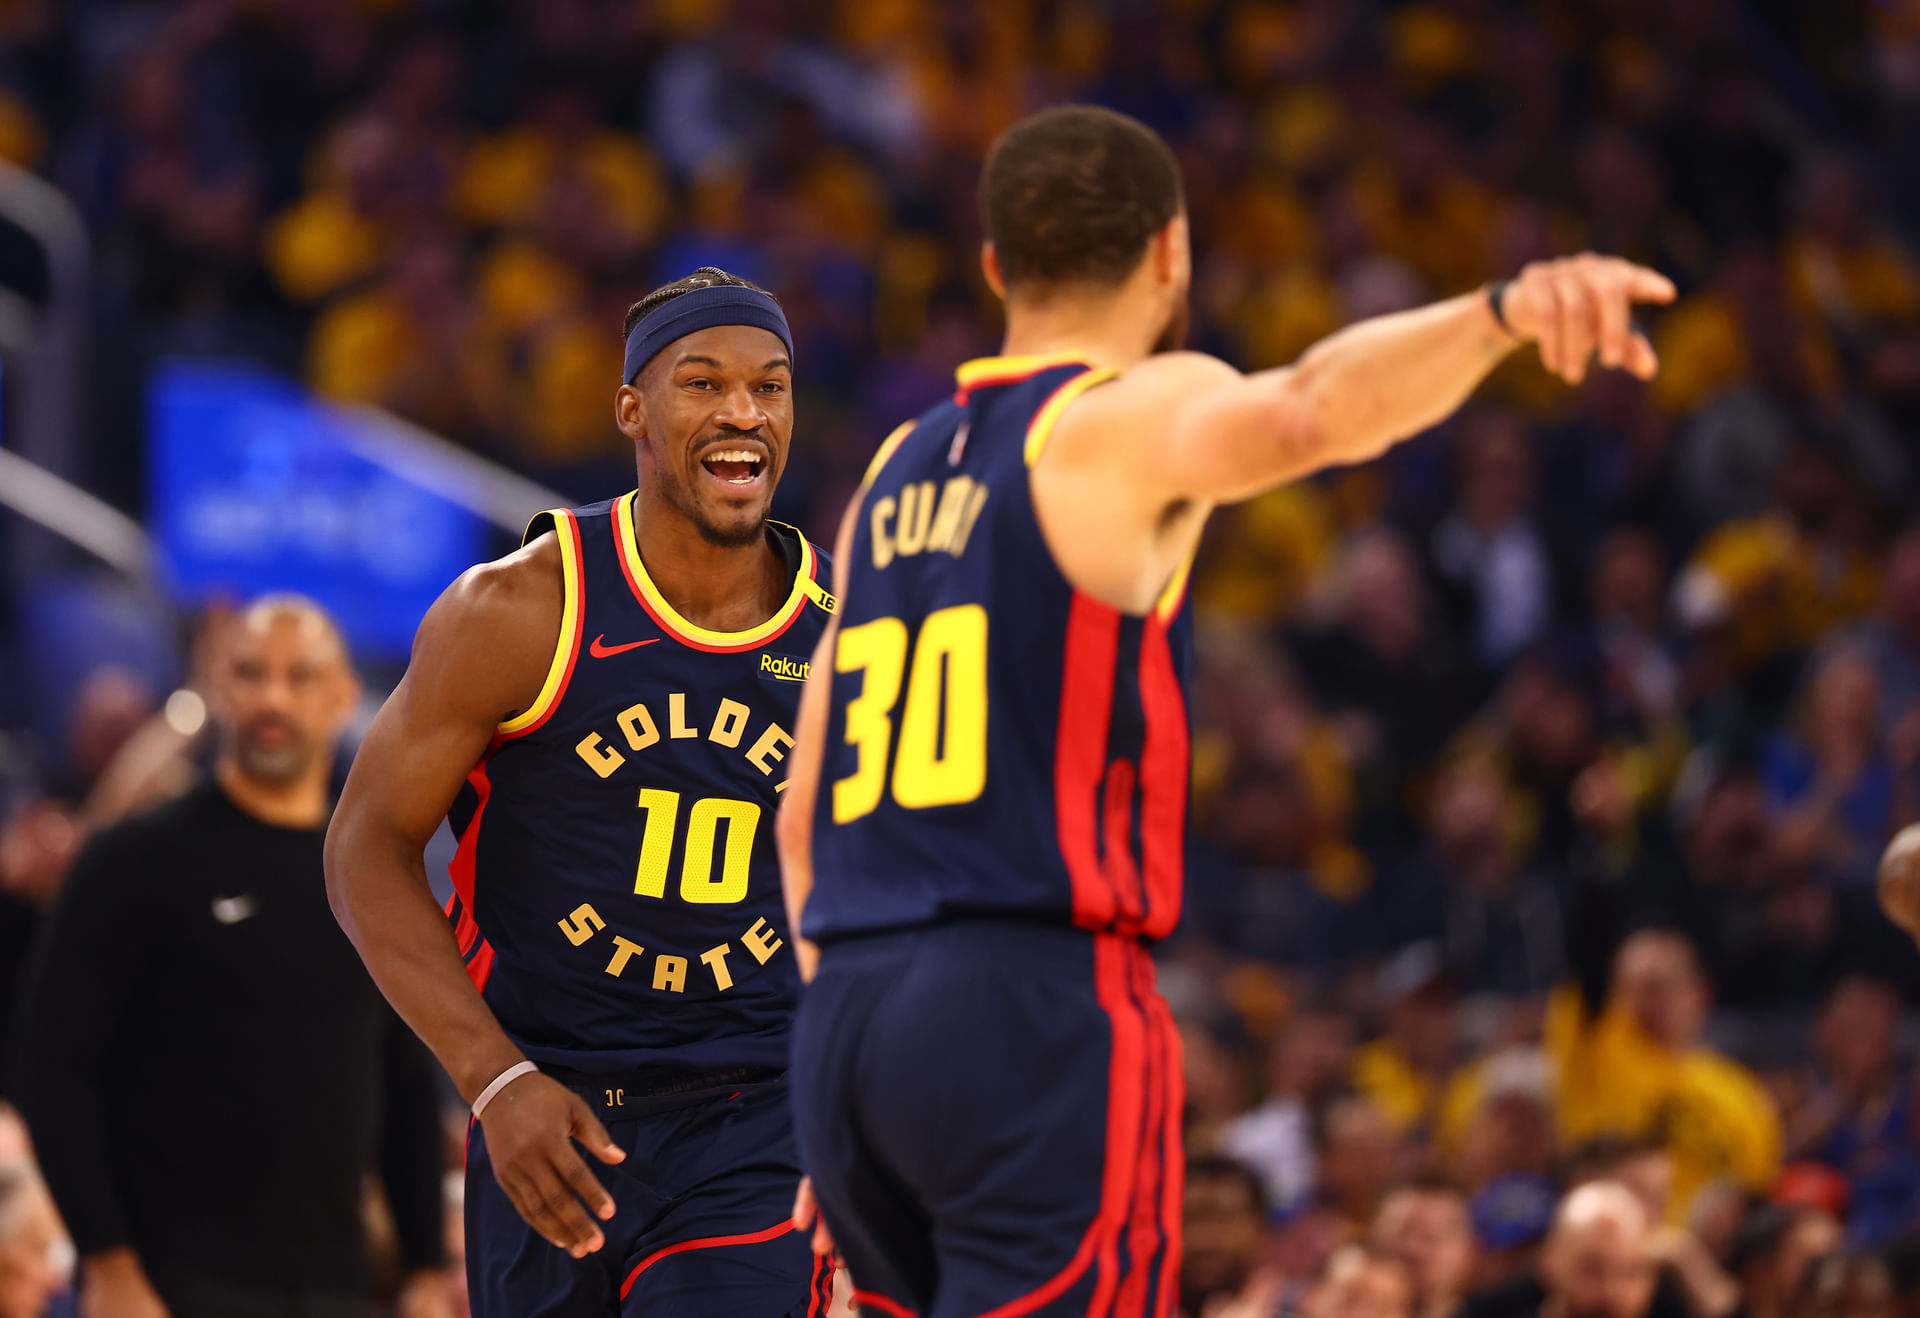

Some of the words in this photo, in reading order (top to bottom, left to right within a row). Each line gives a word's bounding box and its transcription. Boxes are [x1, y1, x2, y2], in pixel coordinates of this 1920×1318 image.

[760, 653, 813, 679] Rakut
[831, 602, 989, 825] 30
[575, 692, 797, 794] GOLDE
[634, 788, 763, 904] 10
[557, 903, 784, 993] STATE
